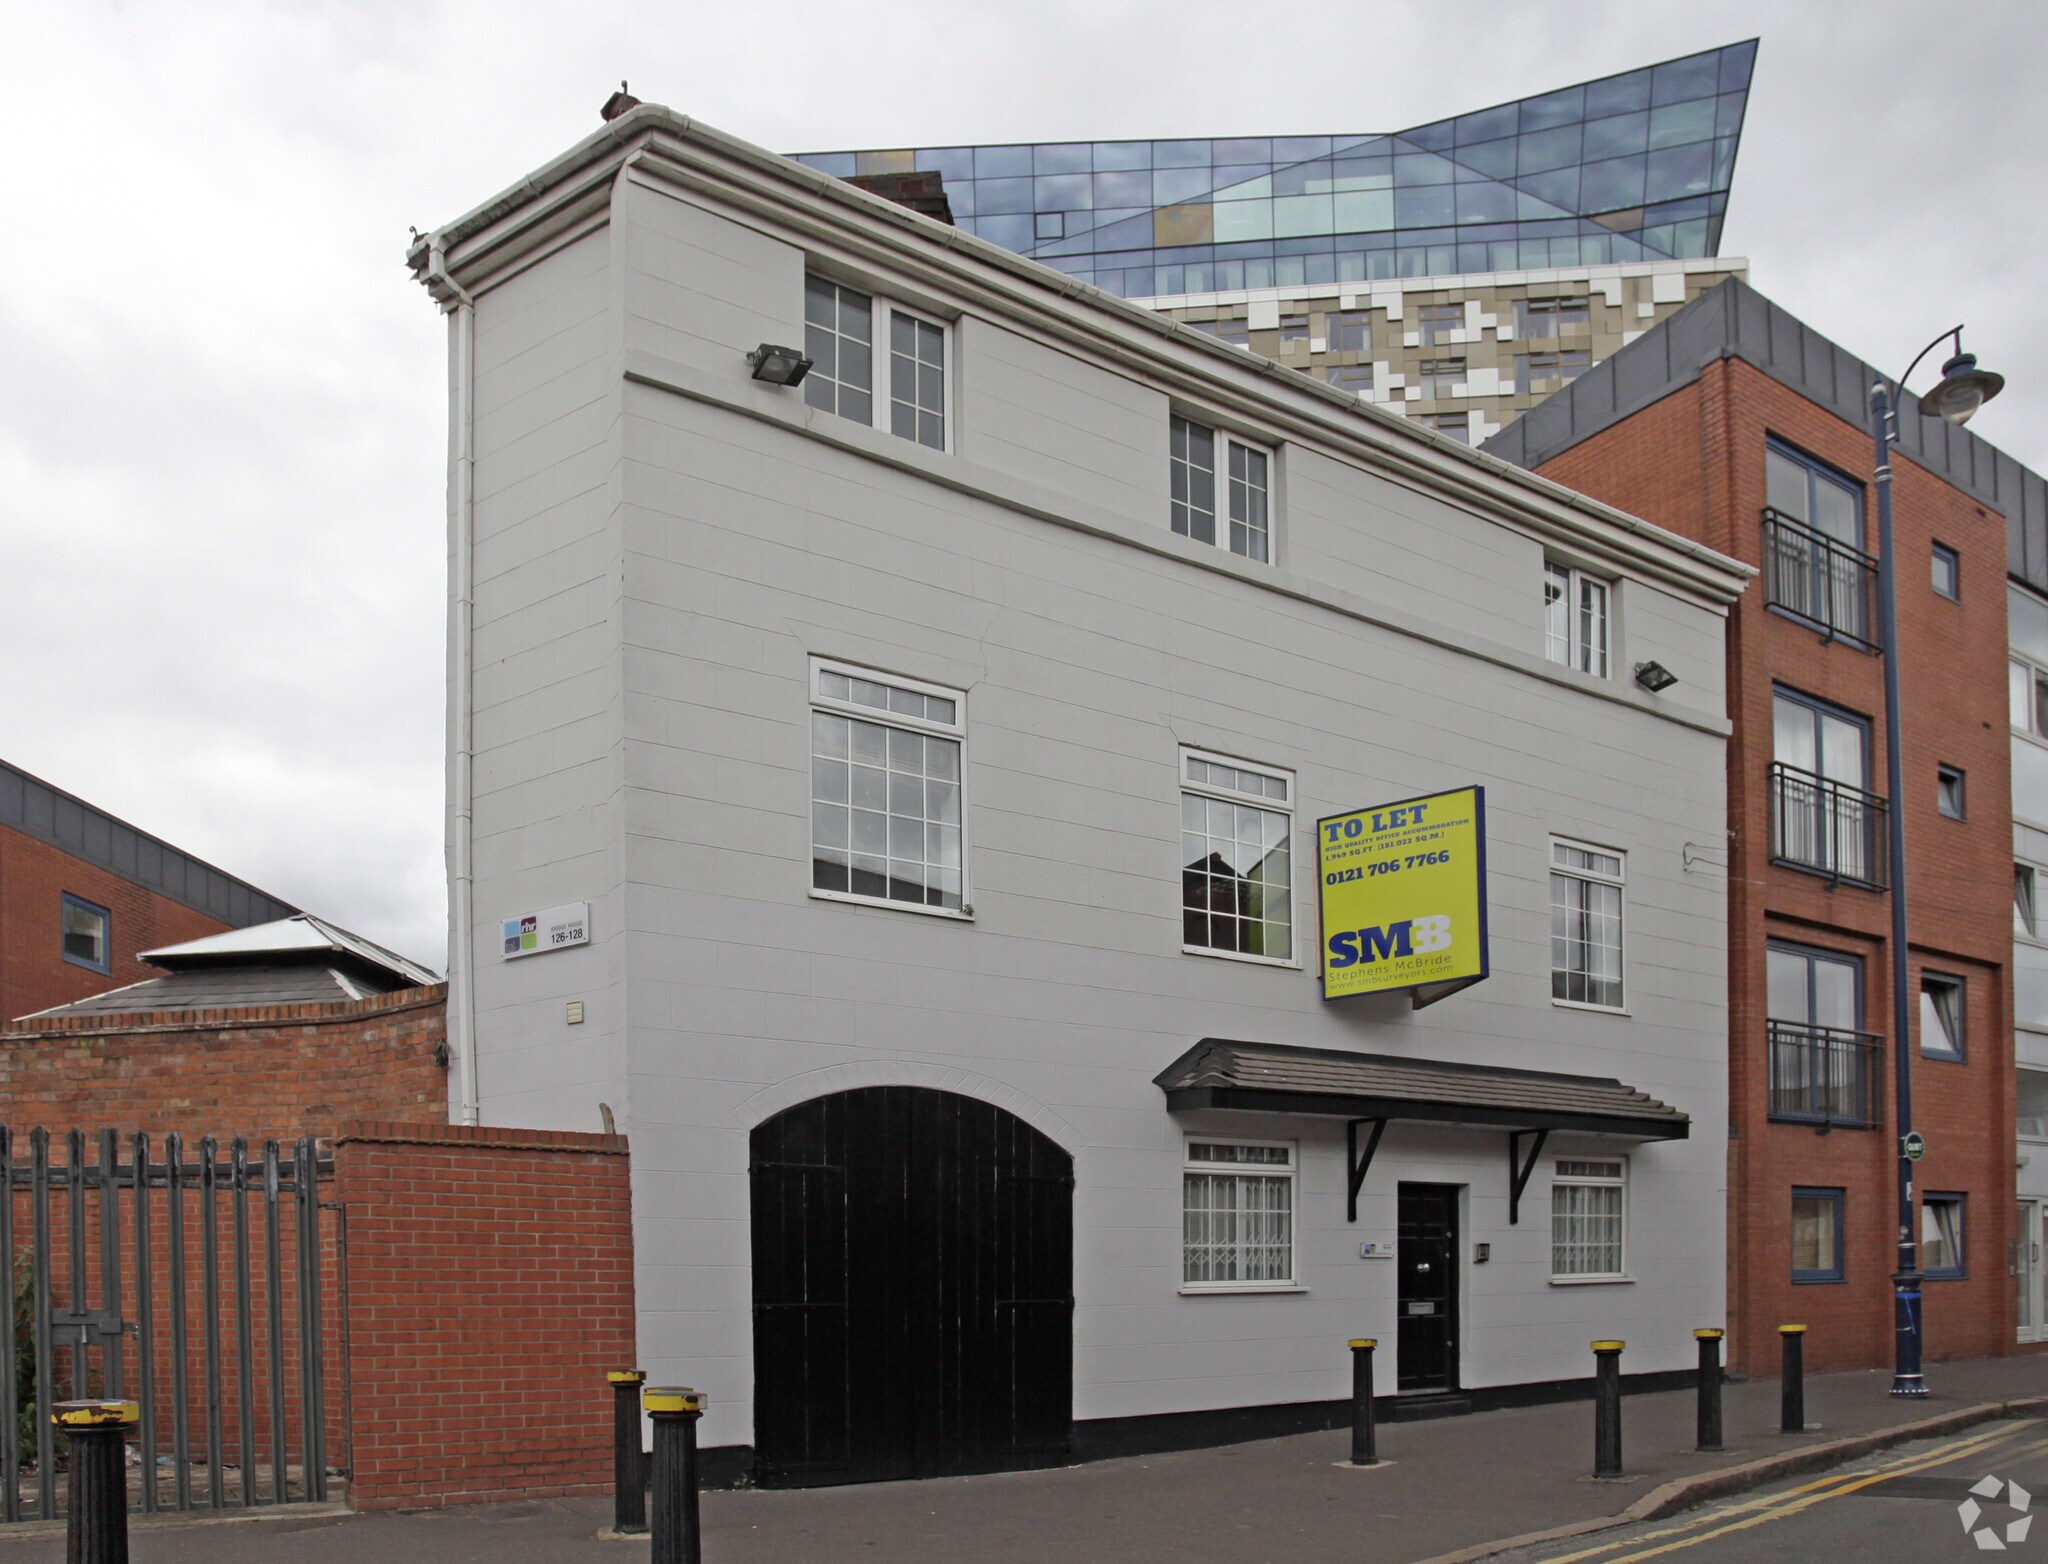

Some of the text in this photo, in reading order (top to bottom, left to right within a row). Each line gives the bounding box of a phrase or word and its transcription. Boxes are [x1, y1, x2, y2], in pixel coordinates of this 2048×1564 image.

[1324, 804, 1428, 843] TO LET
[1325, 818, 1470, 852] HIGH QUALITY OFFICE ACCOMMODATION
[1326, 849, 1450, 886] 0121 706 7766
[521, 921, 537, 933] rhr
[551, 928, 583, 944] 126-128
[1328, 914, 1453, 969] SMB
[1328, 954, 1453, 982] Stephens McBride
[1329, 964, 1454, 990] www.smbsurveyors.com
